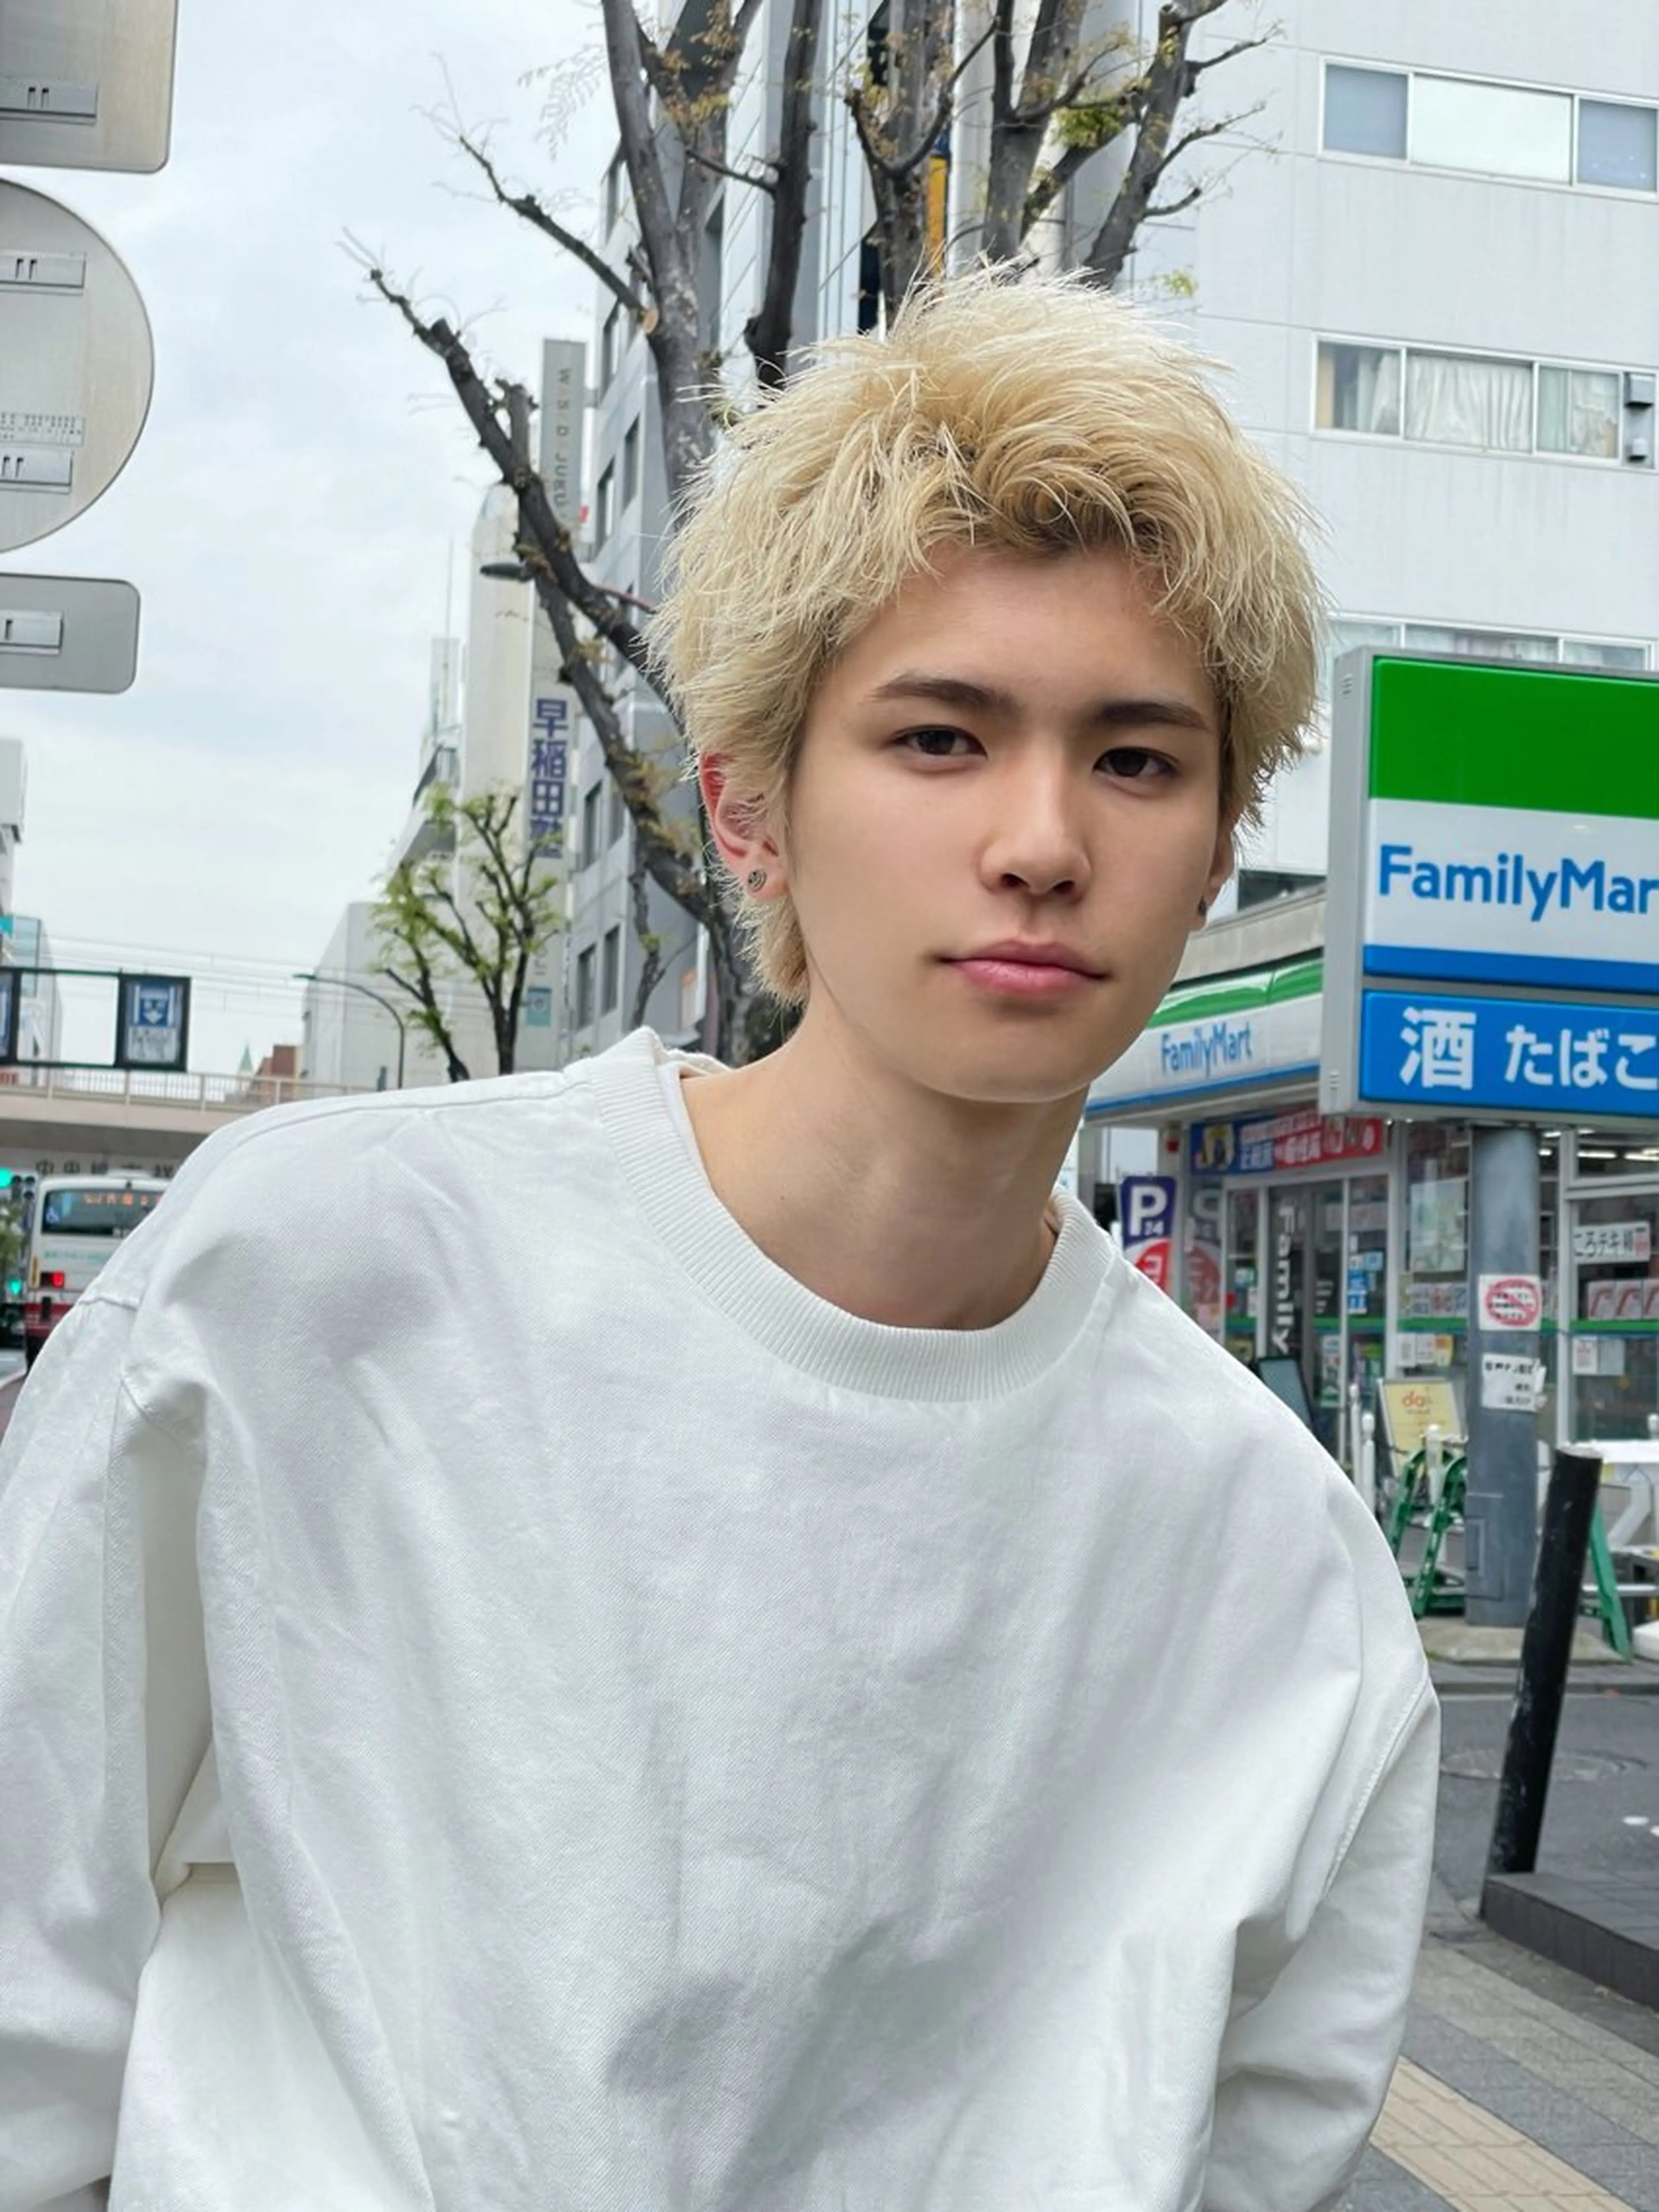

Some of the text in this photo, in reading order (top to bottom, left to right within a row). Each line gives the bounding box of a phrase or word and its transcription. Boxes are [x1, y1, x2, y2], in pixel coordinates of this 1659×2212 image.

[1161, 1022, 1252, 1077] FamilyMart
[1399, 1006, 1659, 1091] 酒 たばこ
[1129, 1185, 1167, 1237] P
